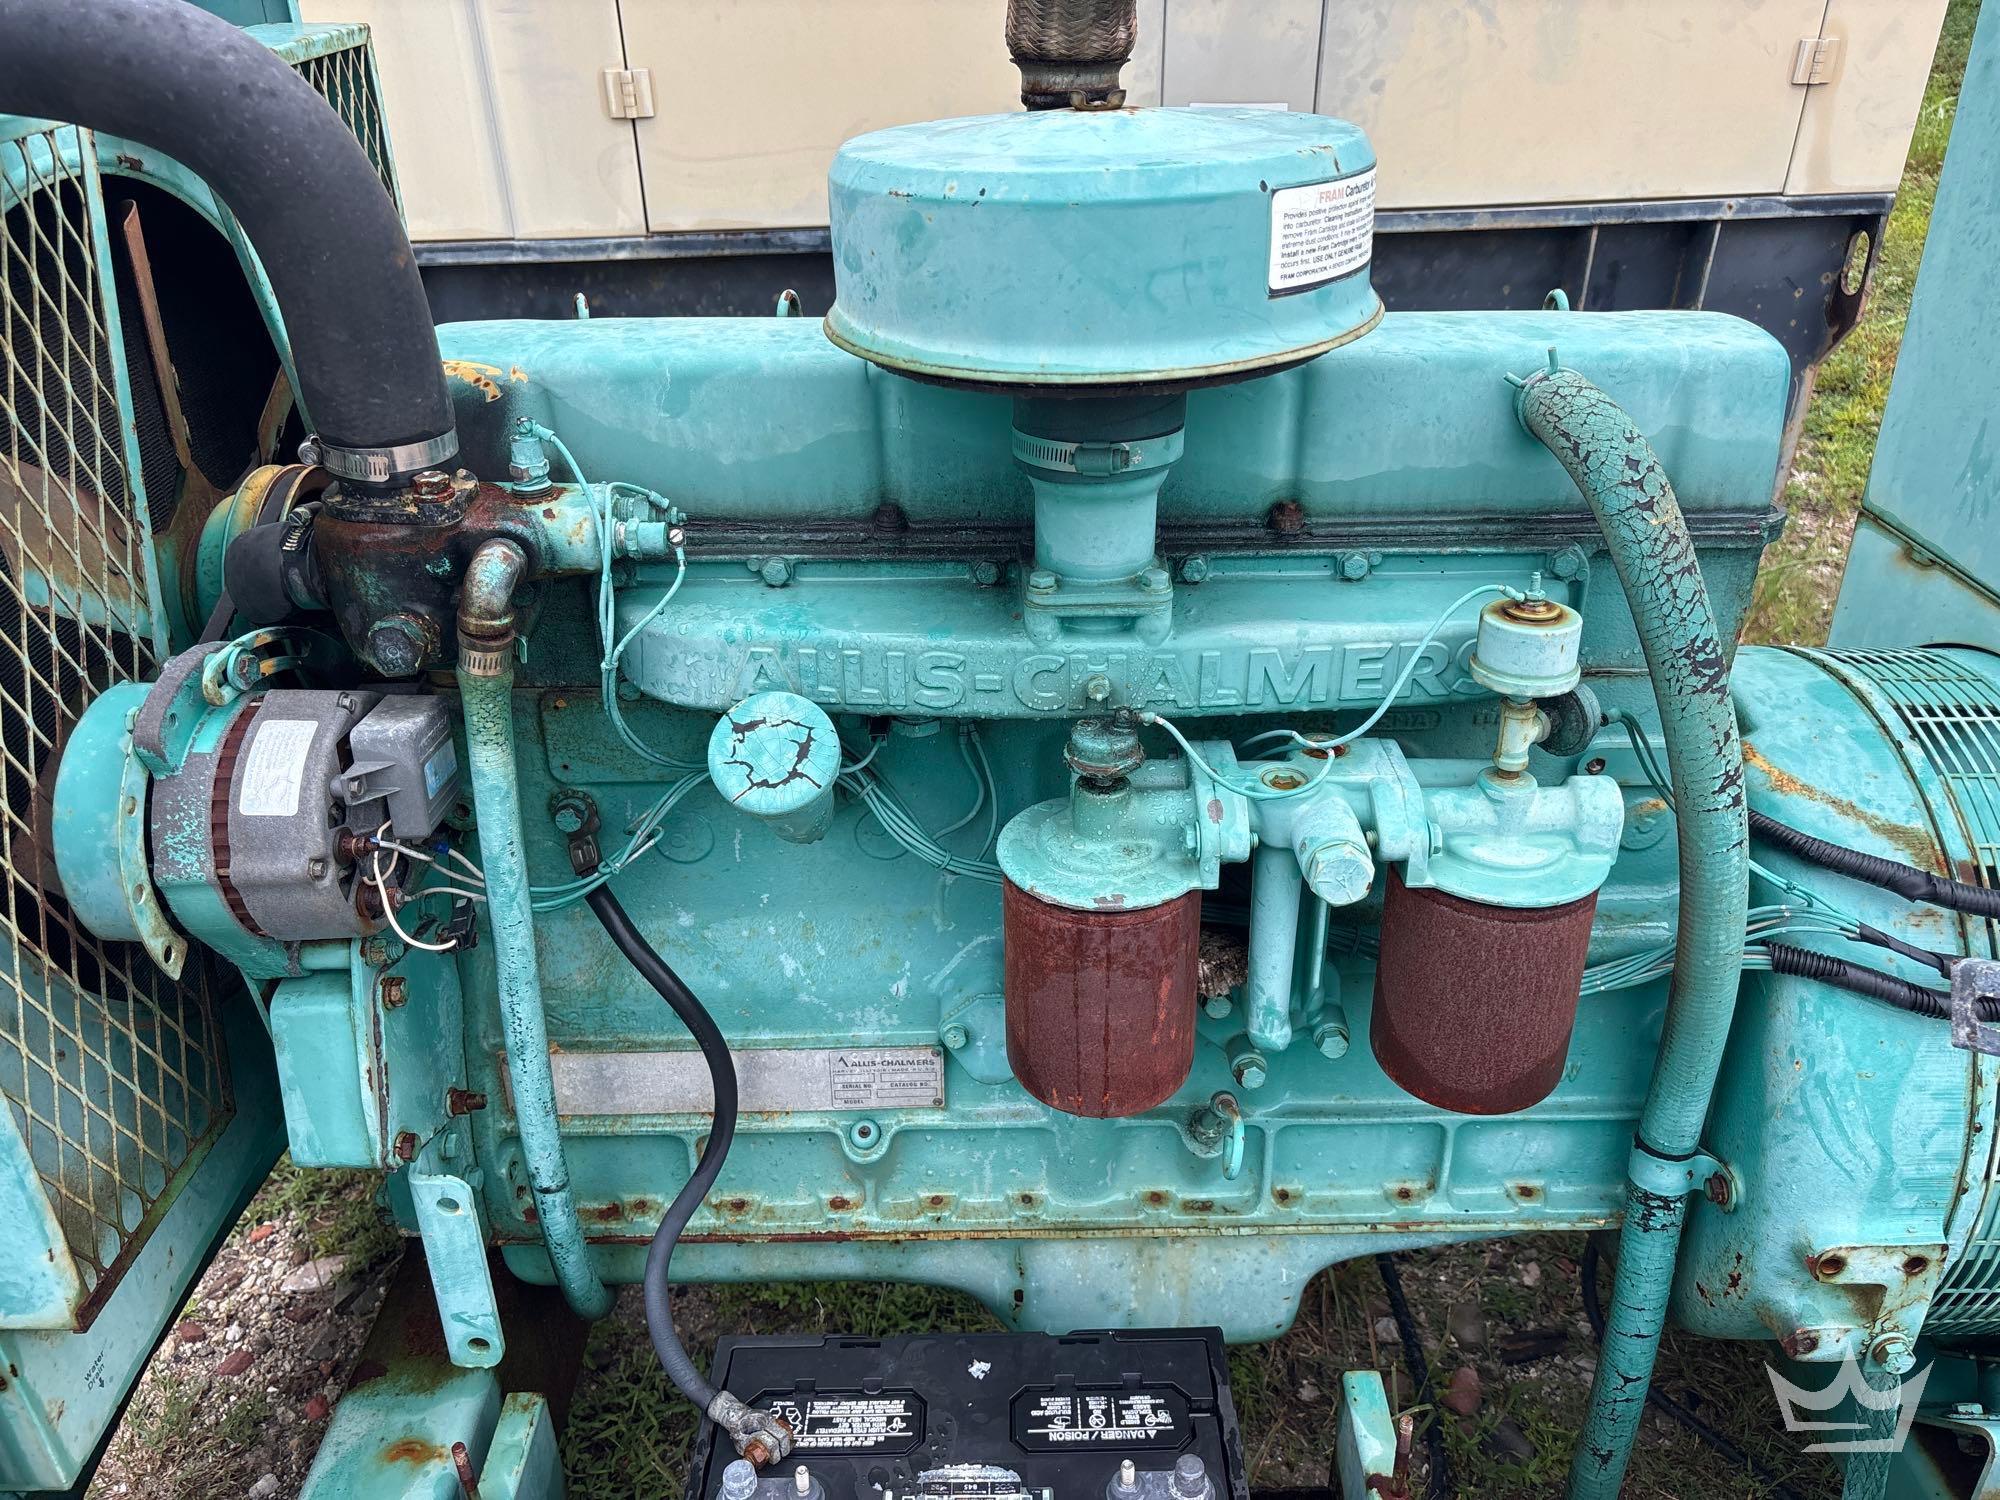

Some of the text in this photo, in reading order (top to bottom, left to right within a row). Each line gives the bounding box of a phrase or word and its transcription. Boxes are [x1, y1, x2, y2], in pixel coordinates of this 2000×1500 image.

[1319, 187, 1344, 203] FRAM
[1283, 211, 1307, 220] Provides
[1313, 255, 1323, 263] USE
[851, 1059, 935, 1067] ALLIS-CHALMERS
[84, 1350, 103, 1380] Water
[88, 1363, 104, 1391] Drain
[1049, 1431, 1089, 1441] POISON
[1100, 1430, 1146, 1440] DANGER
